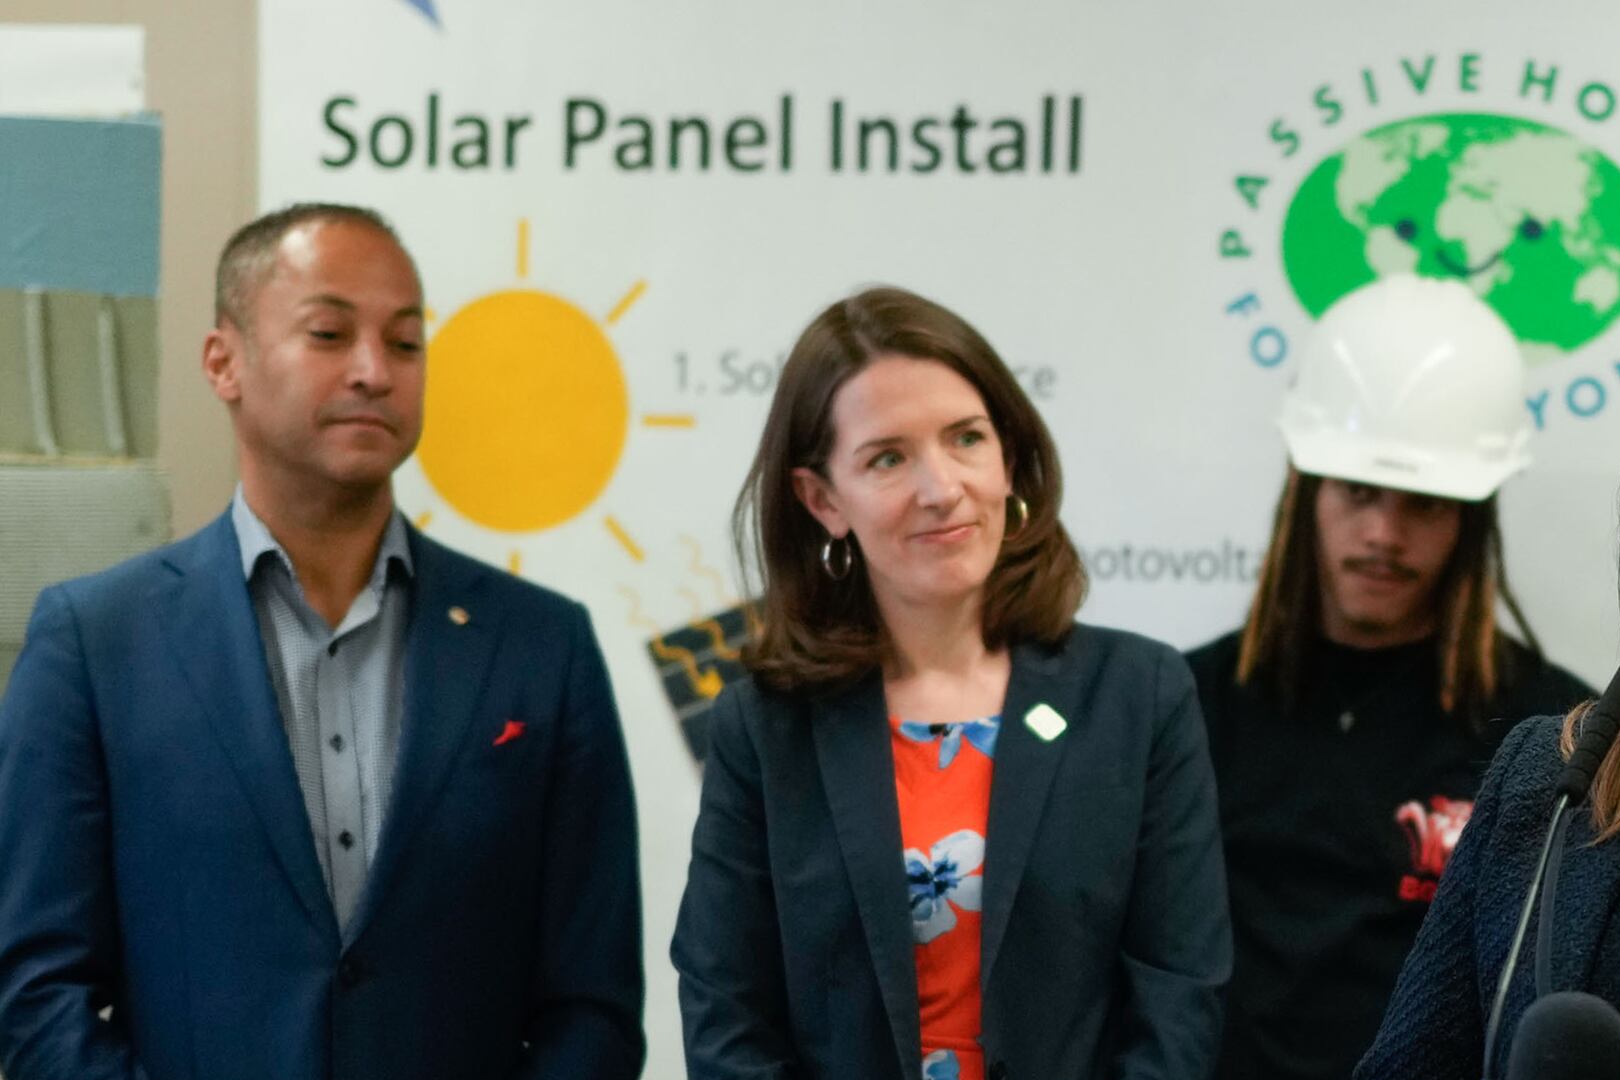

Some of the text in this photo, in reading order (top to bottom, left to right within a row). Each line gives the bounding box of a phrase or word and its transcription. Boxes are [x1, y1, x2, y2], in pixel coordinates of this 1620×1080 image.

[320, 91, 1085, 174] Solar Panel Install
[1220, 53, 1481, 259] PASSIVE
[1226, 291, 1290, 371] FO
